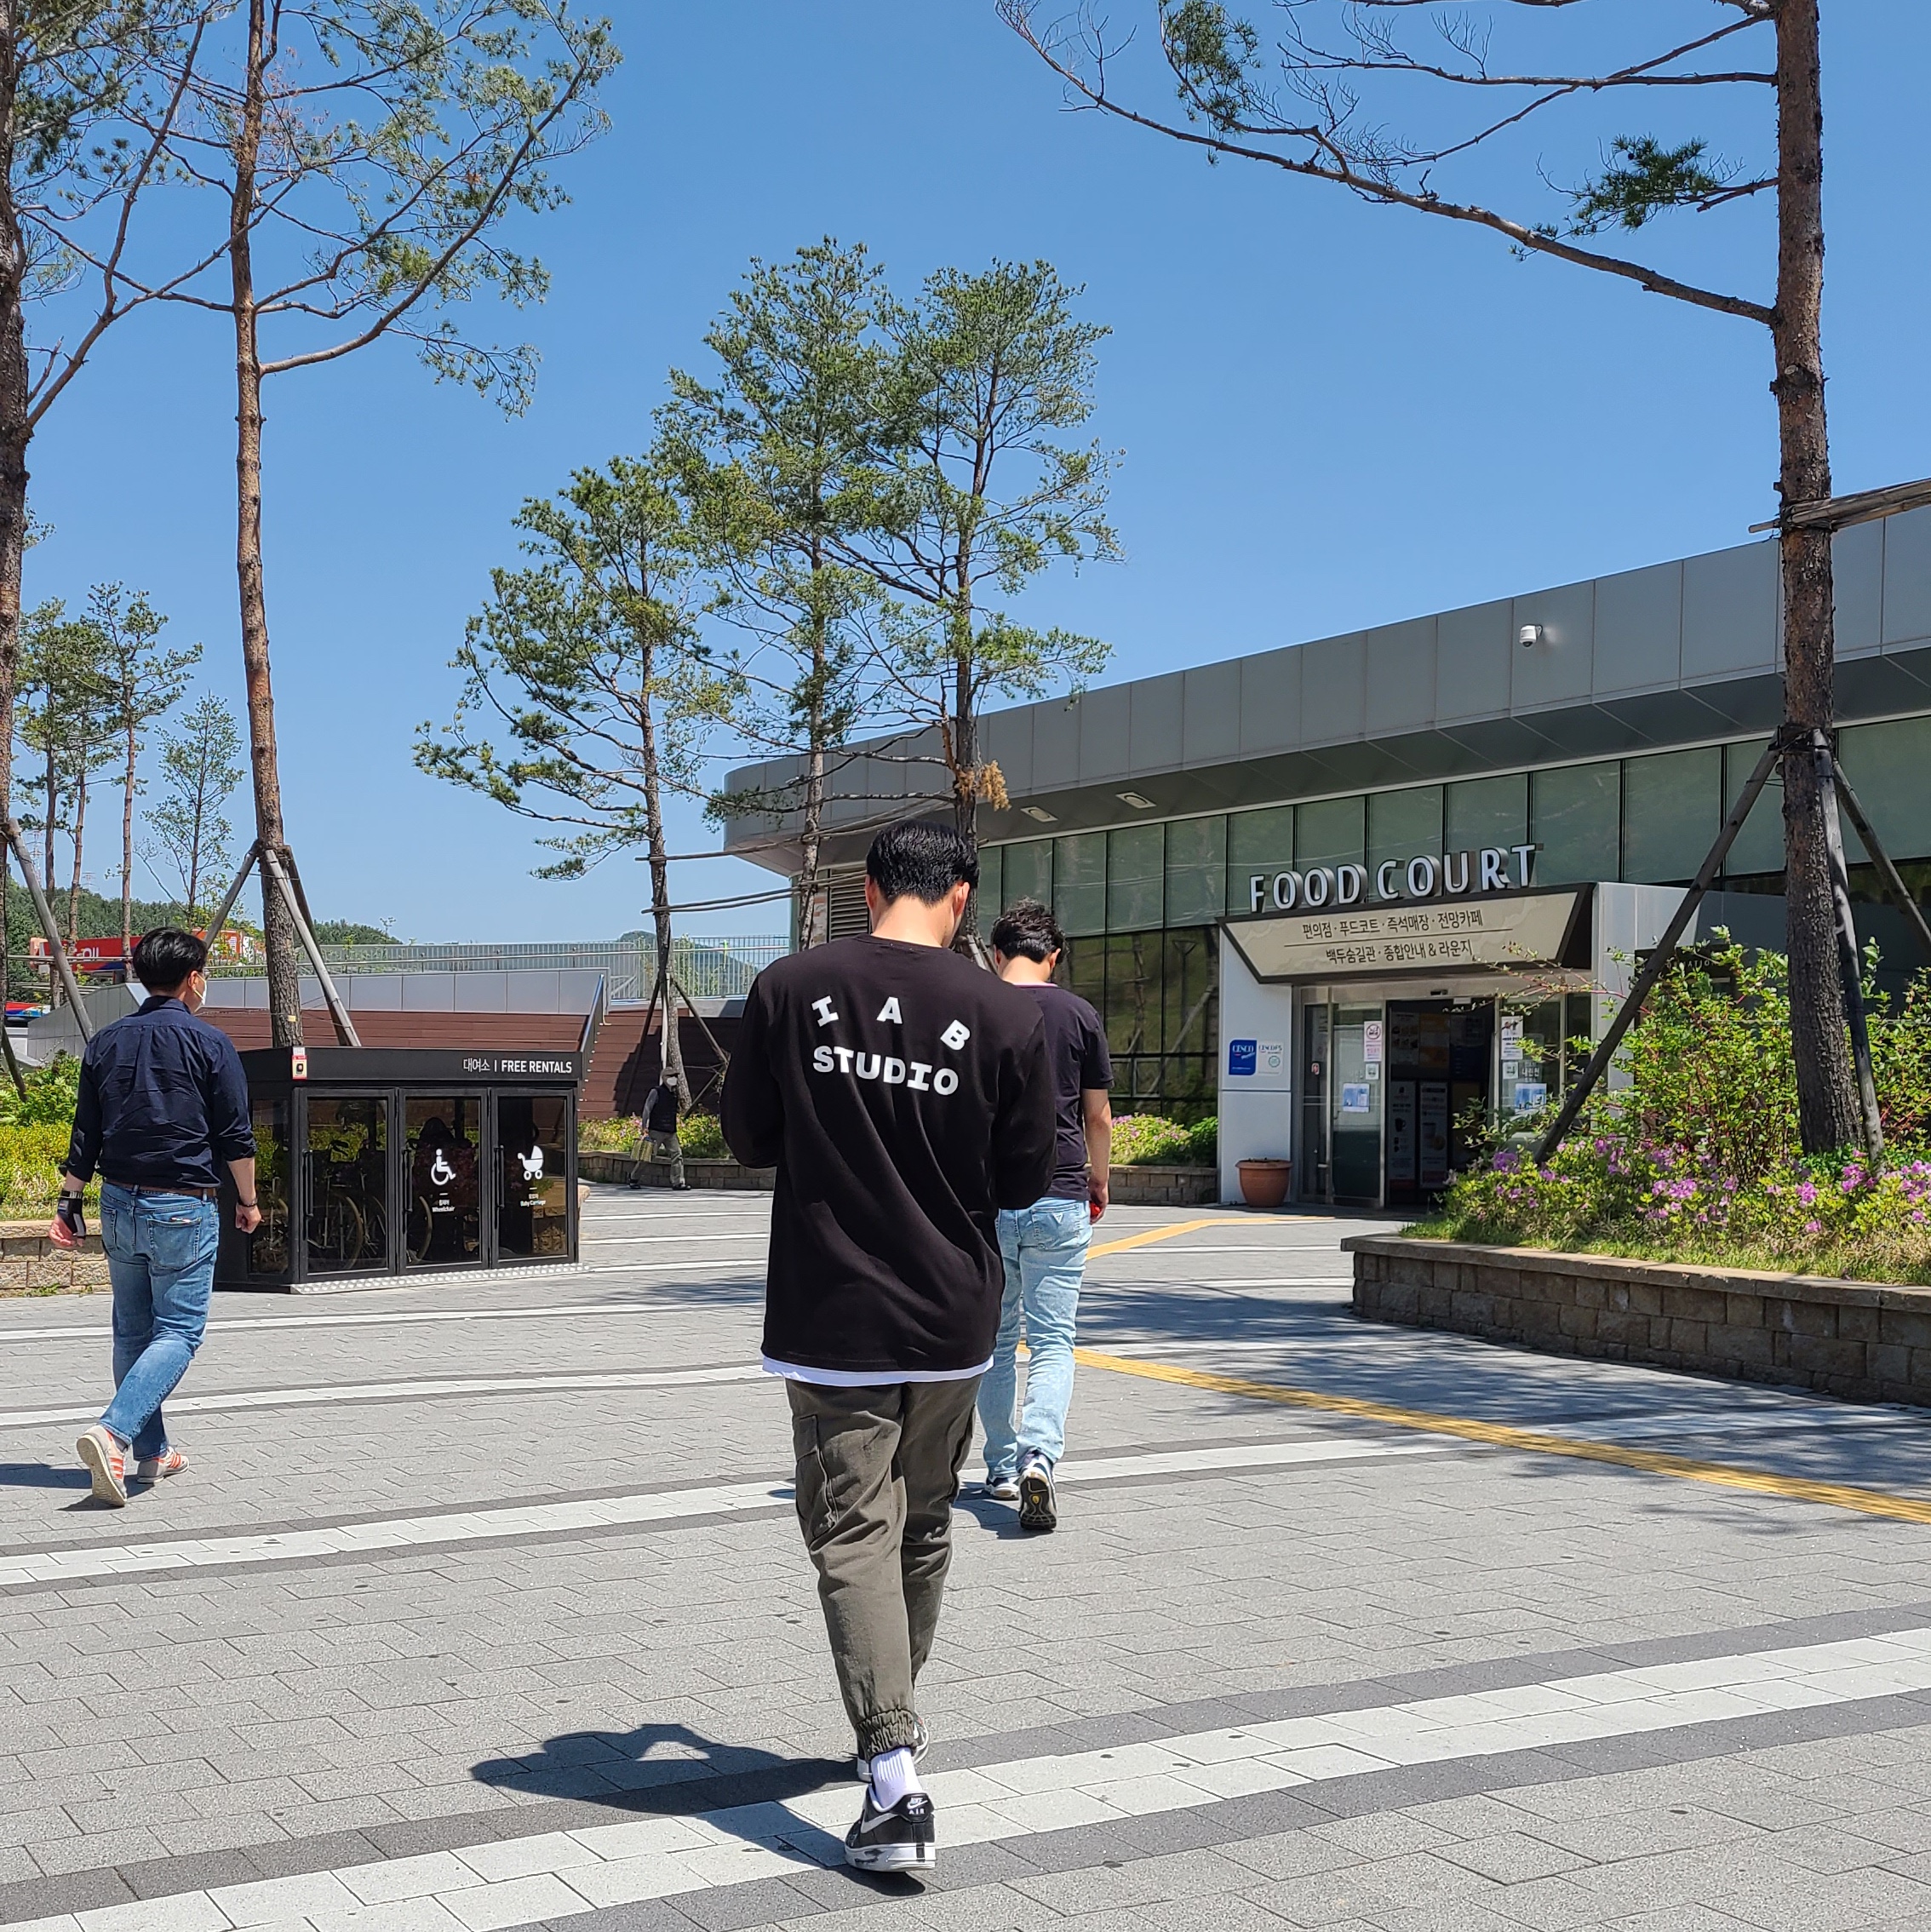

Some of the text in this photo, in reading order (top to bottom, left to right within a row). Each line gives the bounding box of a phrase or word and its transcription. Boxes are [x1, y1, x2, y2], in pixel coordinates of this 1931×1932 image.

[1249, 843, 1542, 913] FOOD COURT
[1303, 909, 1483, 939] 편의점 푸드코트 즉석매장 전망카페
[1326, 946, 1376, 965] 백두숨길관
[1384, 943, 1426, 962] 종합안내
[1439, 939, 1474, 959] 라운지
[811, 995, 971, 1050] I A B
[462, 1058, 490, 1072] 대여소
[501, 1059, 572, 1074] FREE RENTALS
[812, 1046, 959, 1096] STUDIO
